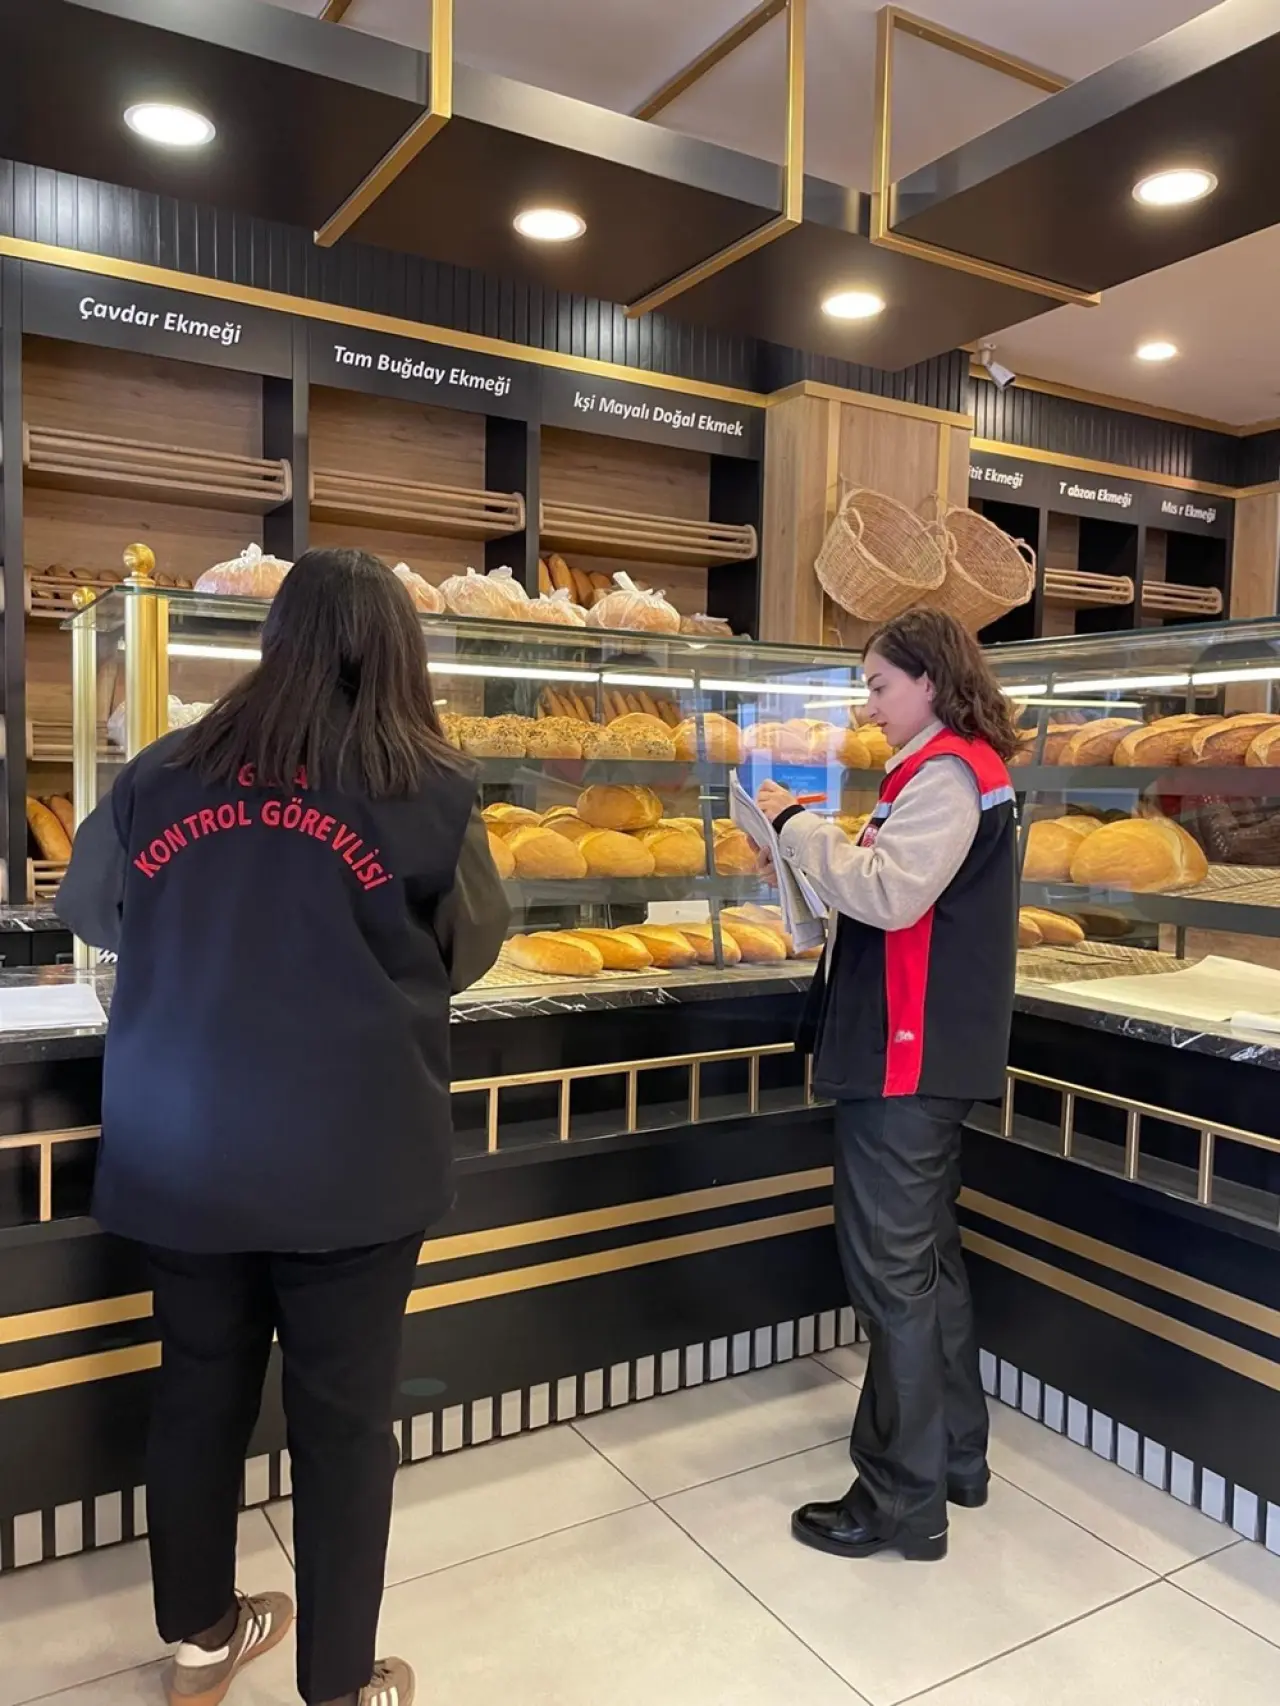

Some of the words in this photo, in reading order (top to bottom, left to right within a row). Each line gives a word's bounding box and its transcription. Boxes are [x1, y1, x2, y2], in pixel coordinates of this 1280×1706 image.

[79, 296, 160, 327] Çavdar
[163, 312, 242, 346] Ekmeği
[334, 345, 373, 369] Tam
[377, 354, 447, 386] Buğday
[448, 368, 511, 397] Ekmeği
[598, 397, 650, 421] Mayalı
[652, 406, 696, 430] Doğal
[697, 415, 744, 436] Ekmek
[984, 467, 1024, 490] Ekmeği
[1097, 488, 1133, 508] Ekmeği
[133, 800, 253, 879] KONTROL
[260, 797, 393, 891] GÖREVLİSİ
